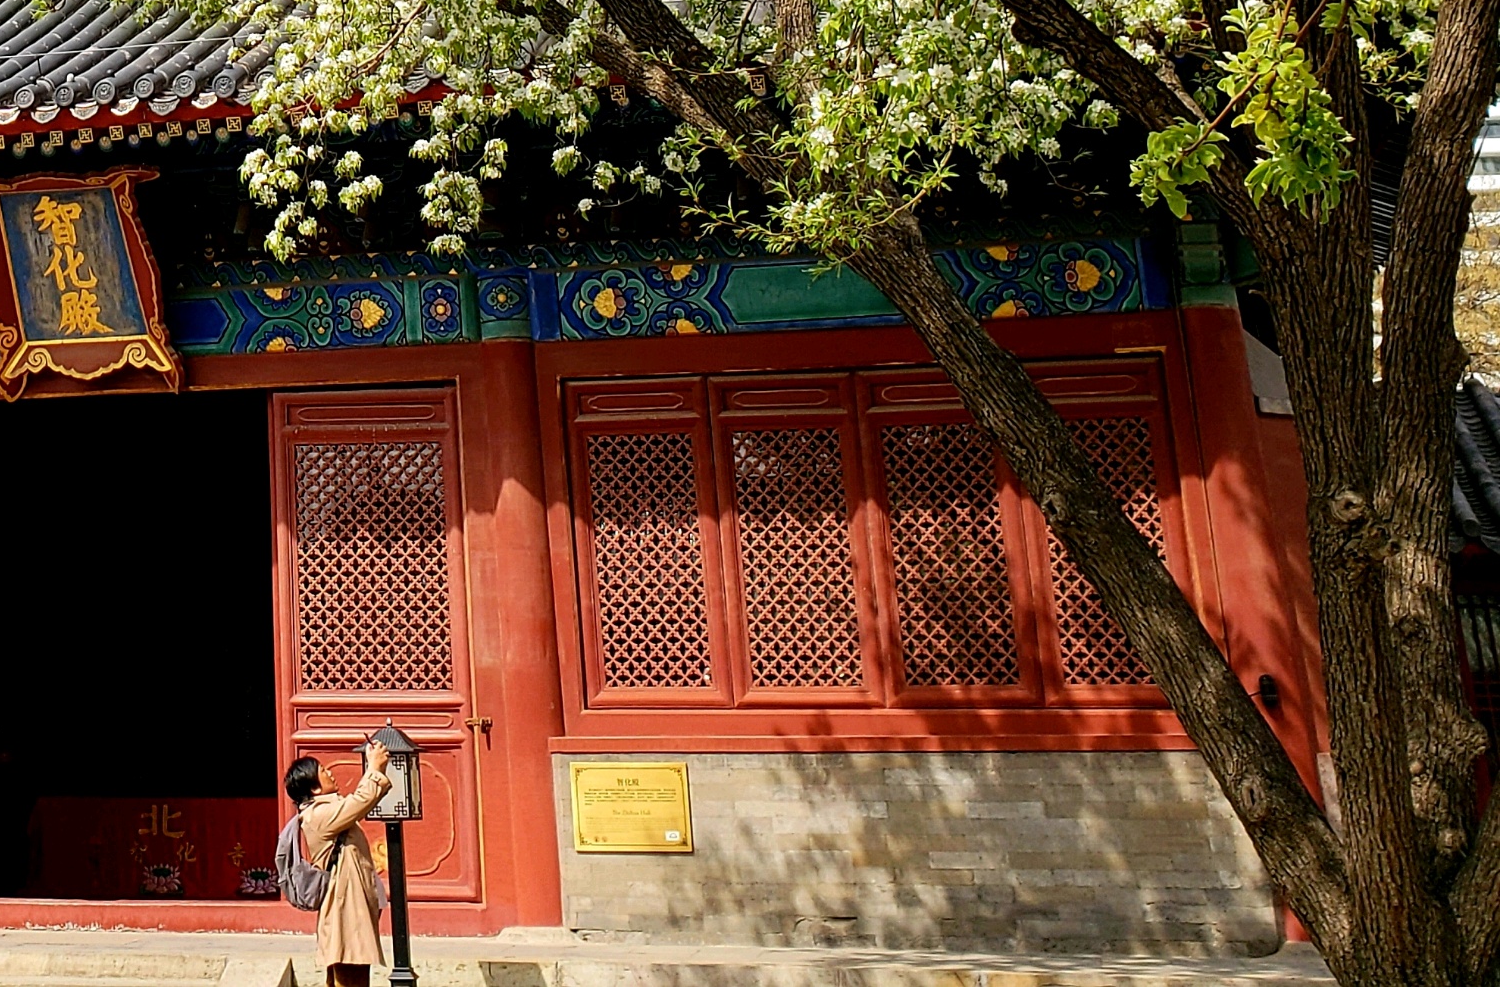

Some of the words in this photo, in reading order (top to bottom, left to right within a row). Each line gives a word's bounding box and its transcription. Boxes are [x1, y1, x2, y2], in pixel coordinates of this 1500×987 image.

[34, 195, 114, 335] 智化殿
[138, 804, 185, 838] 北
